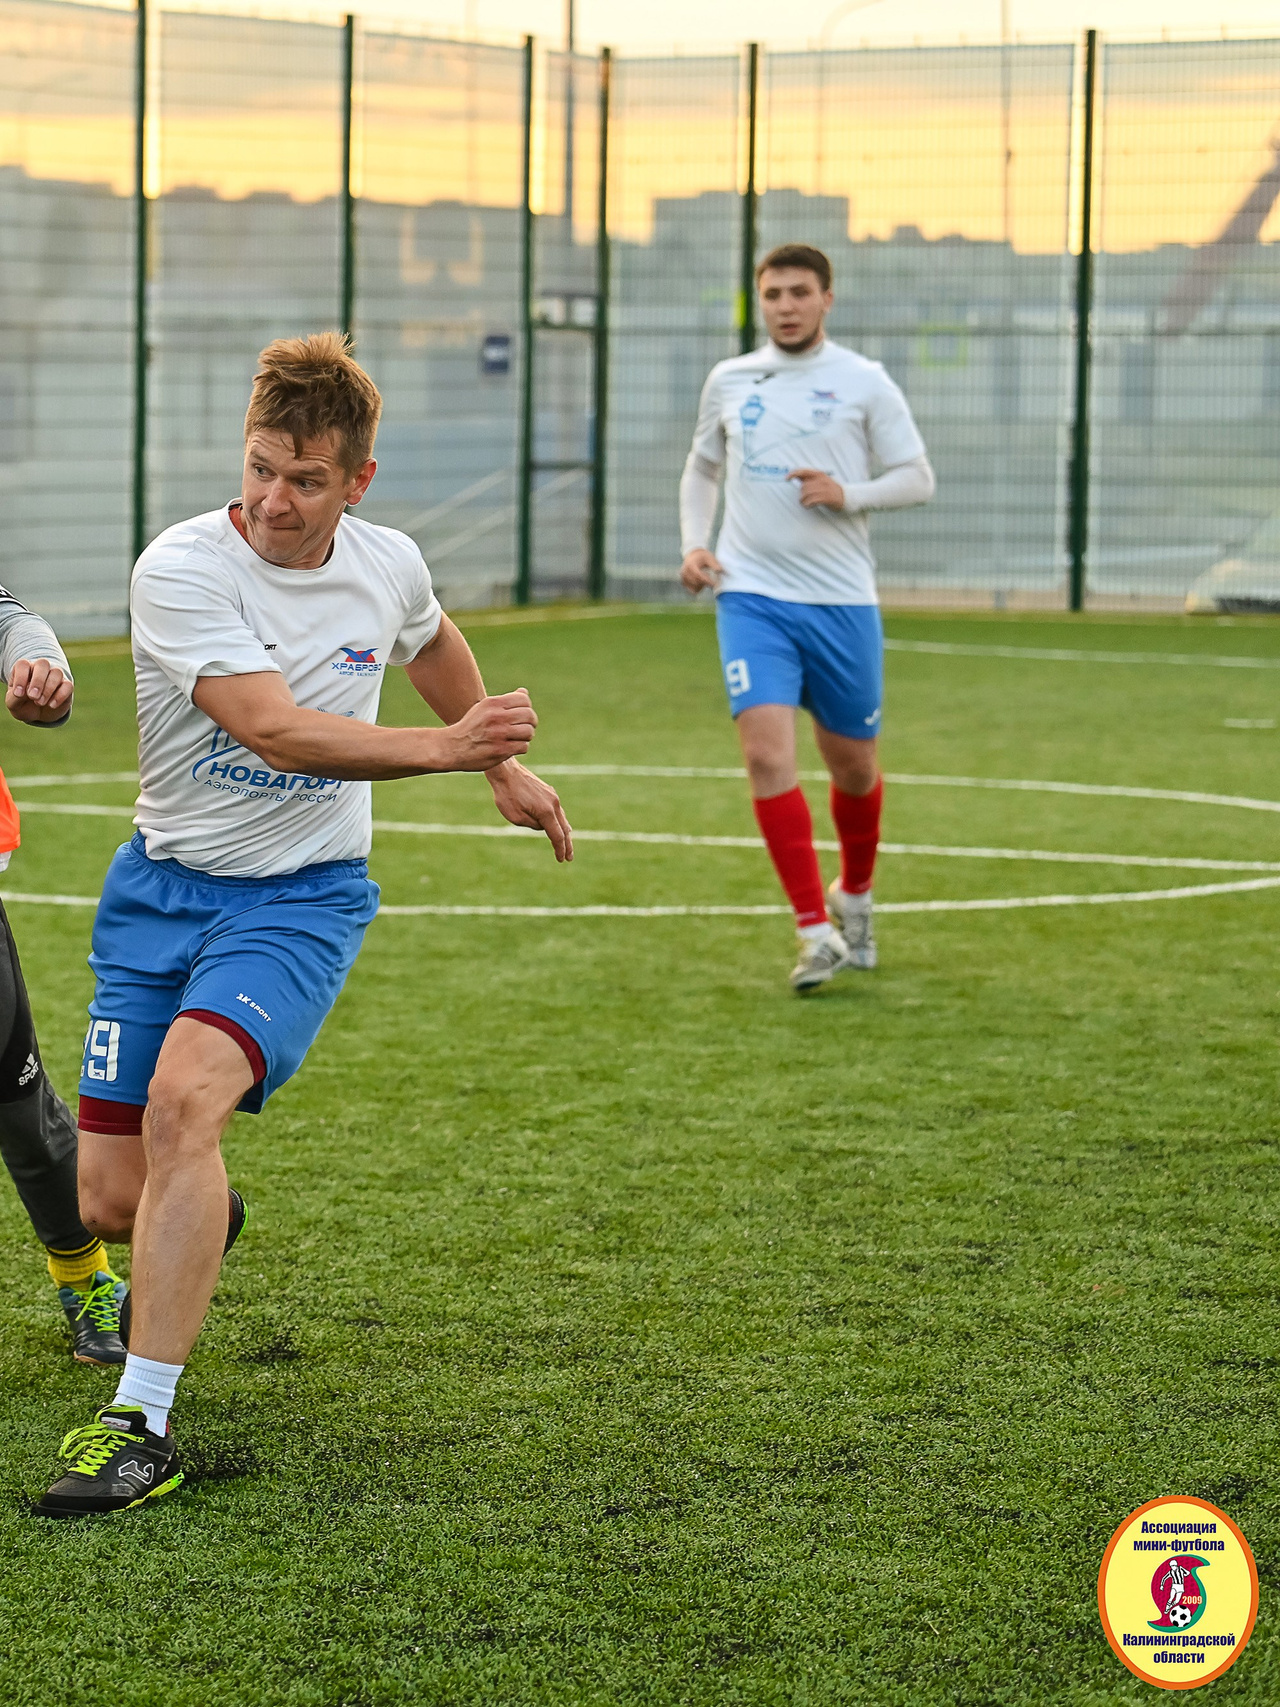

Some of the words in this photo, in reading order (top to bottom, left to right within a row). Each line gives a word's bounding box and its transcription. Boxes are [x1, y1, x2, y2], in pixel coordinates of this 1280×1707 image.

[726, 658, 751, 697] 9
[204, 779, 287, 803] АЭРОПОРТЫ
[249, 1001, 272, 1022] SPORT
